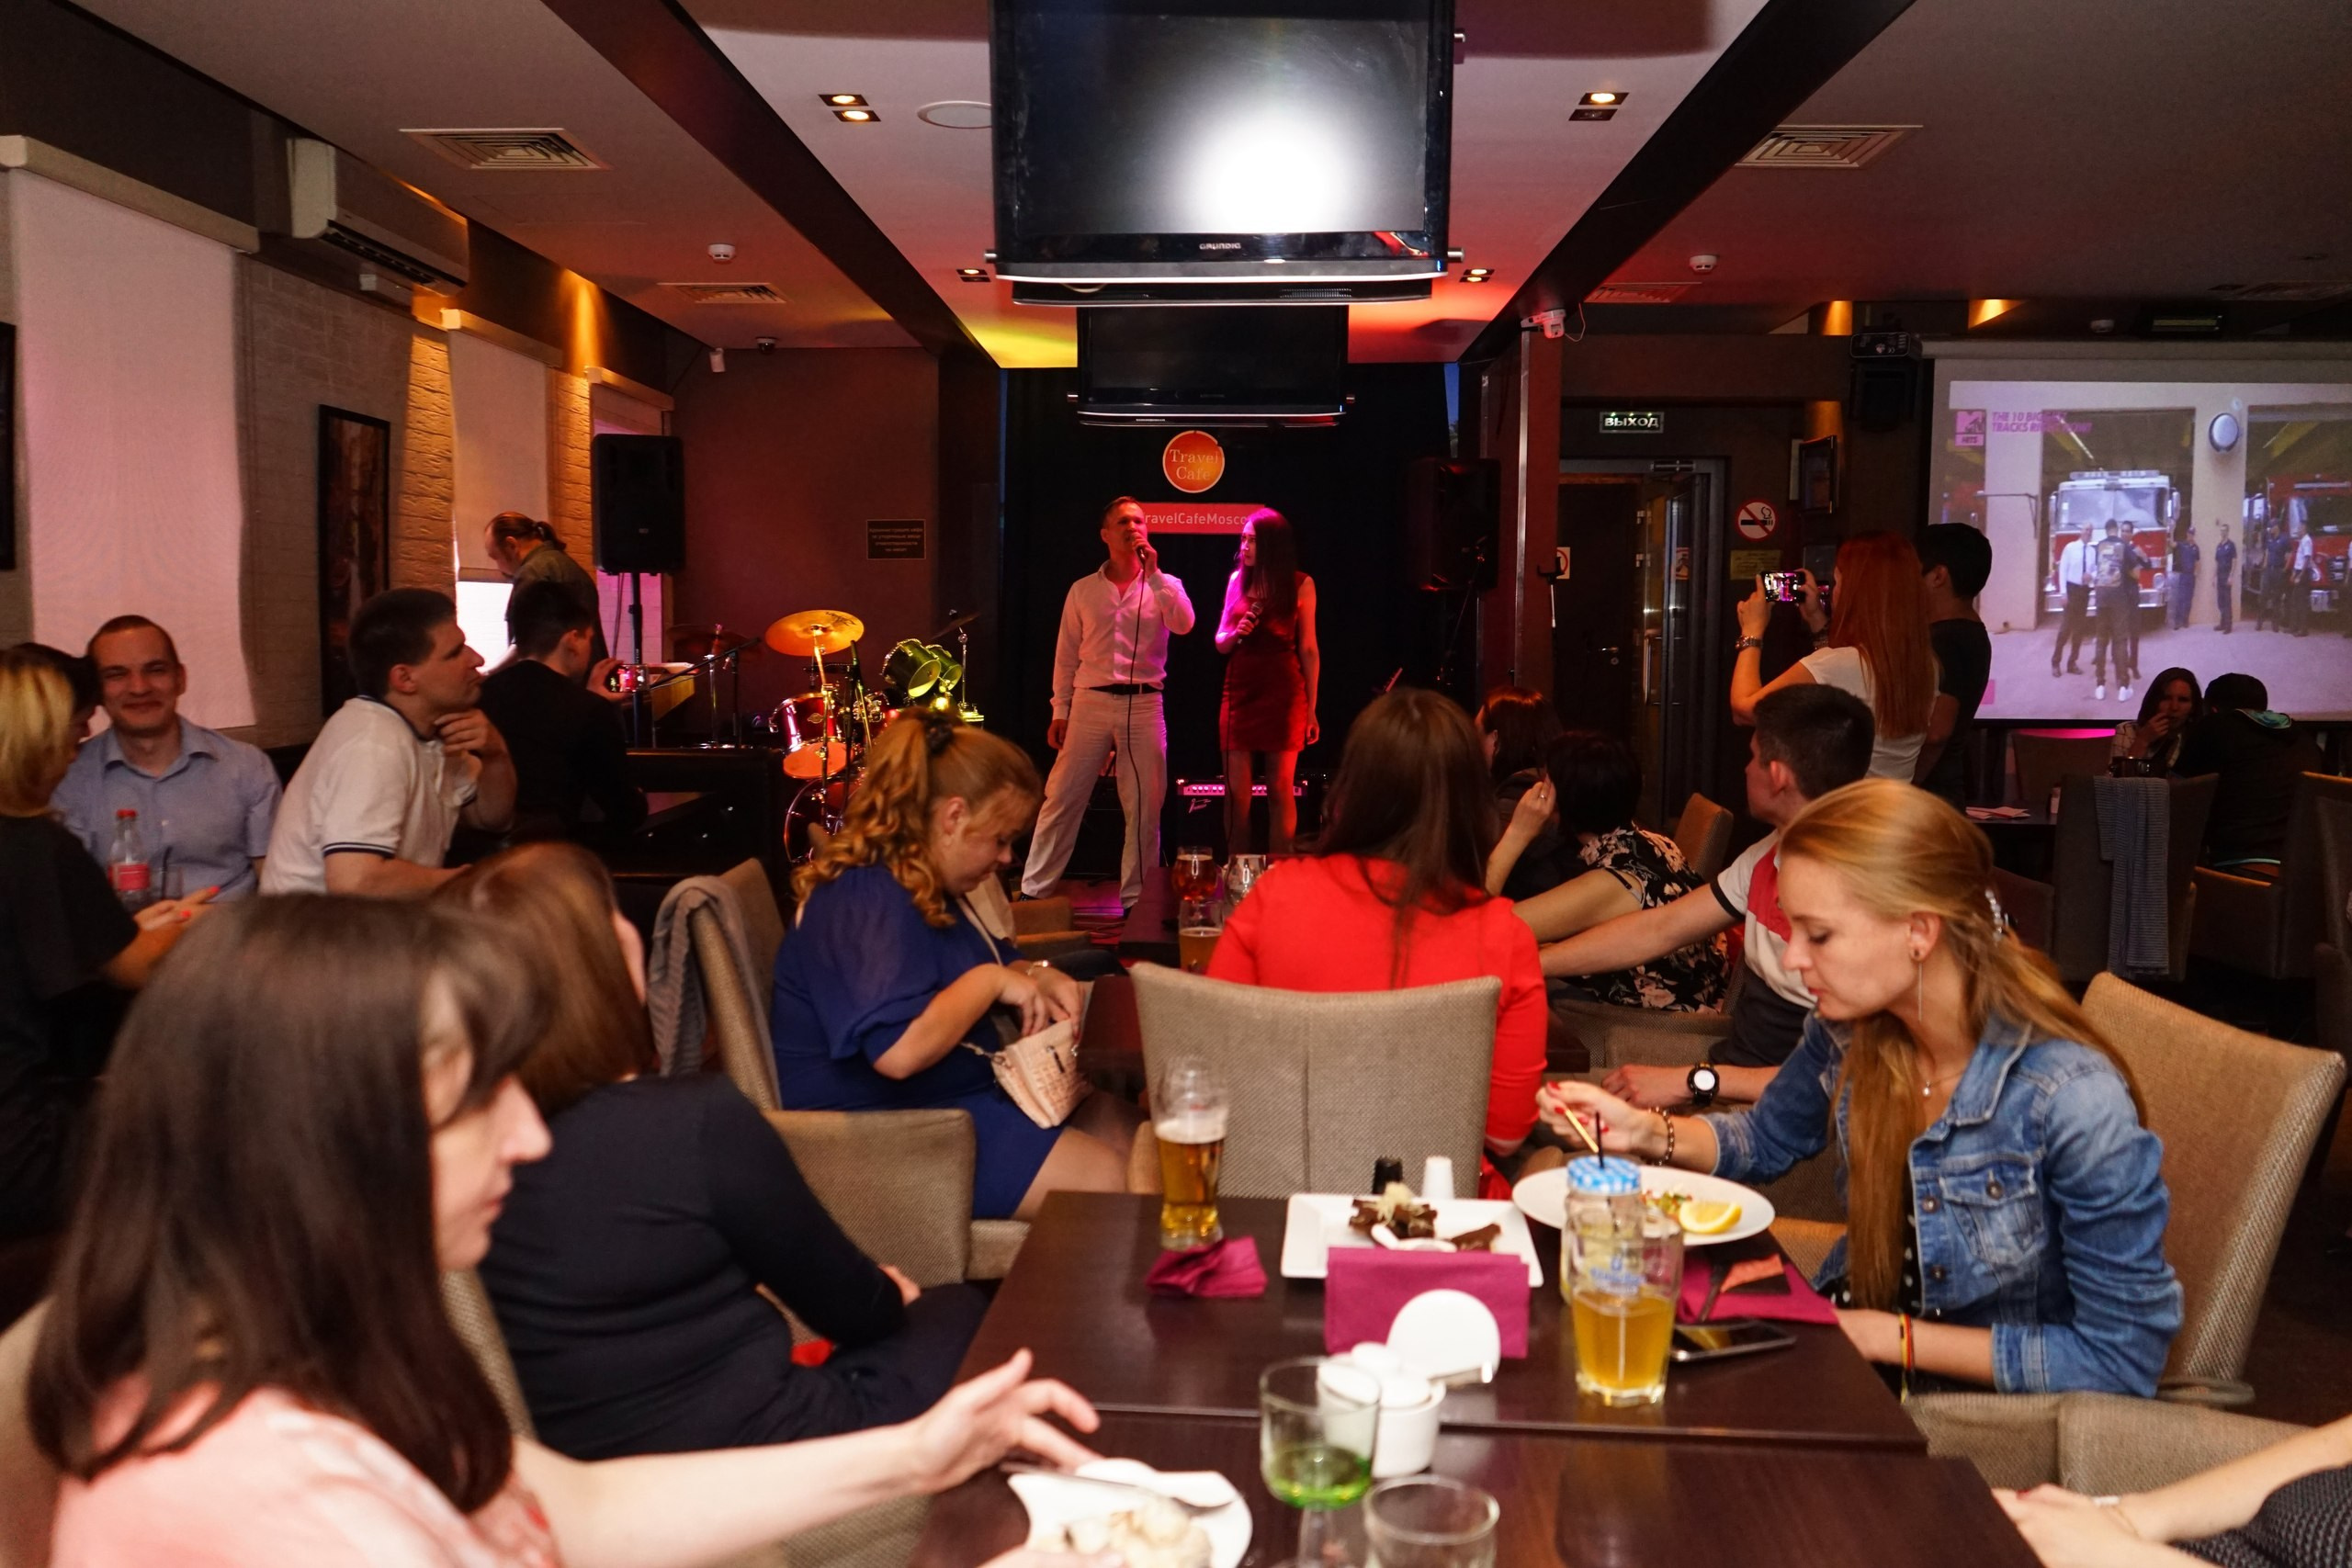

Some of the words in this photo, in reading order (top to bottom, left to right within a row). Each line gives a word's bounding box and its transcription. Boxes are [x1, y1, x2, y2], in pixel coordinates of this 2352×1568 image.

[1604, 417, 1659, 428] ВЫХОД
[1992, 412, 2009, 422] THE
[1170, 449, 1219, 464] Travel
[1176, 467, 1211, 480] Cafe
[1144, 513, 1247, 525] ravelCafeMosco
